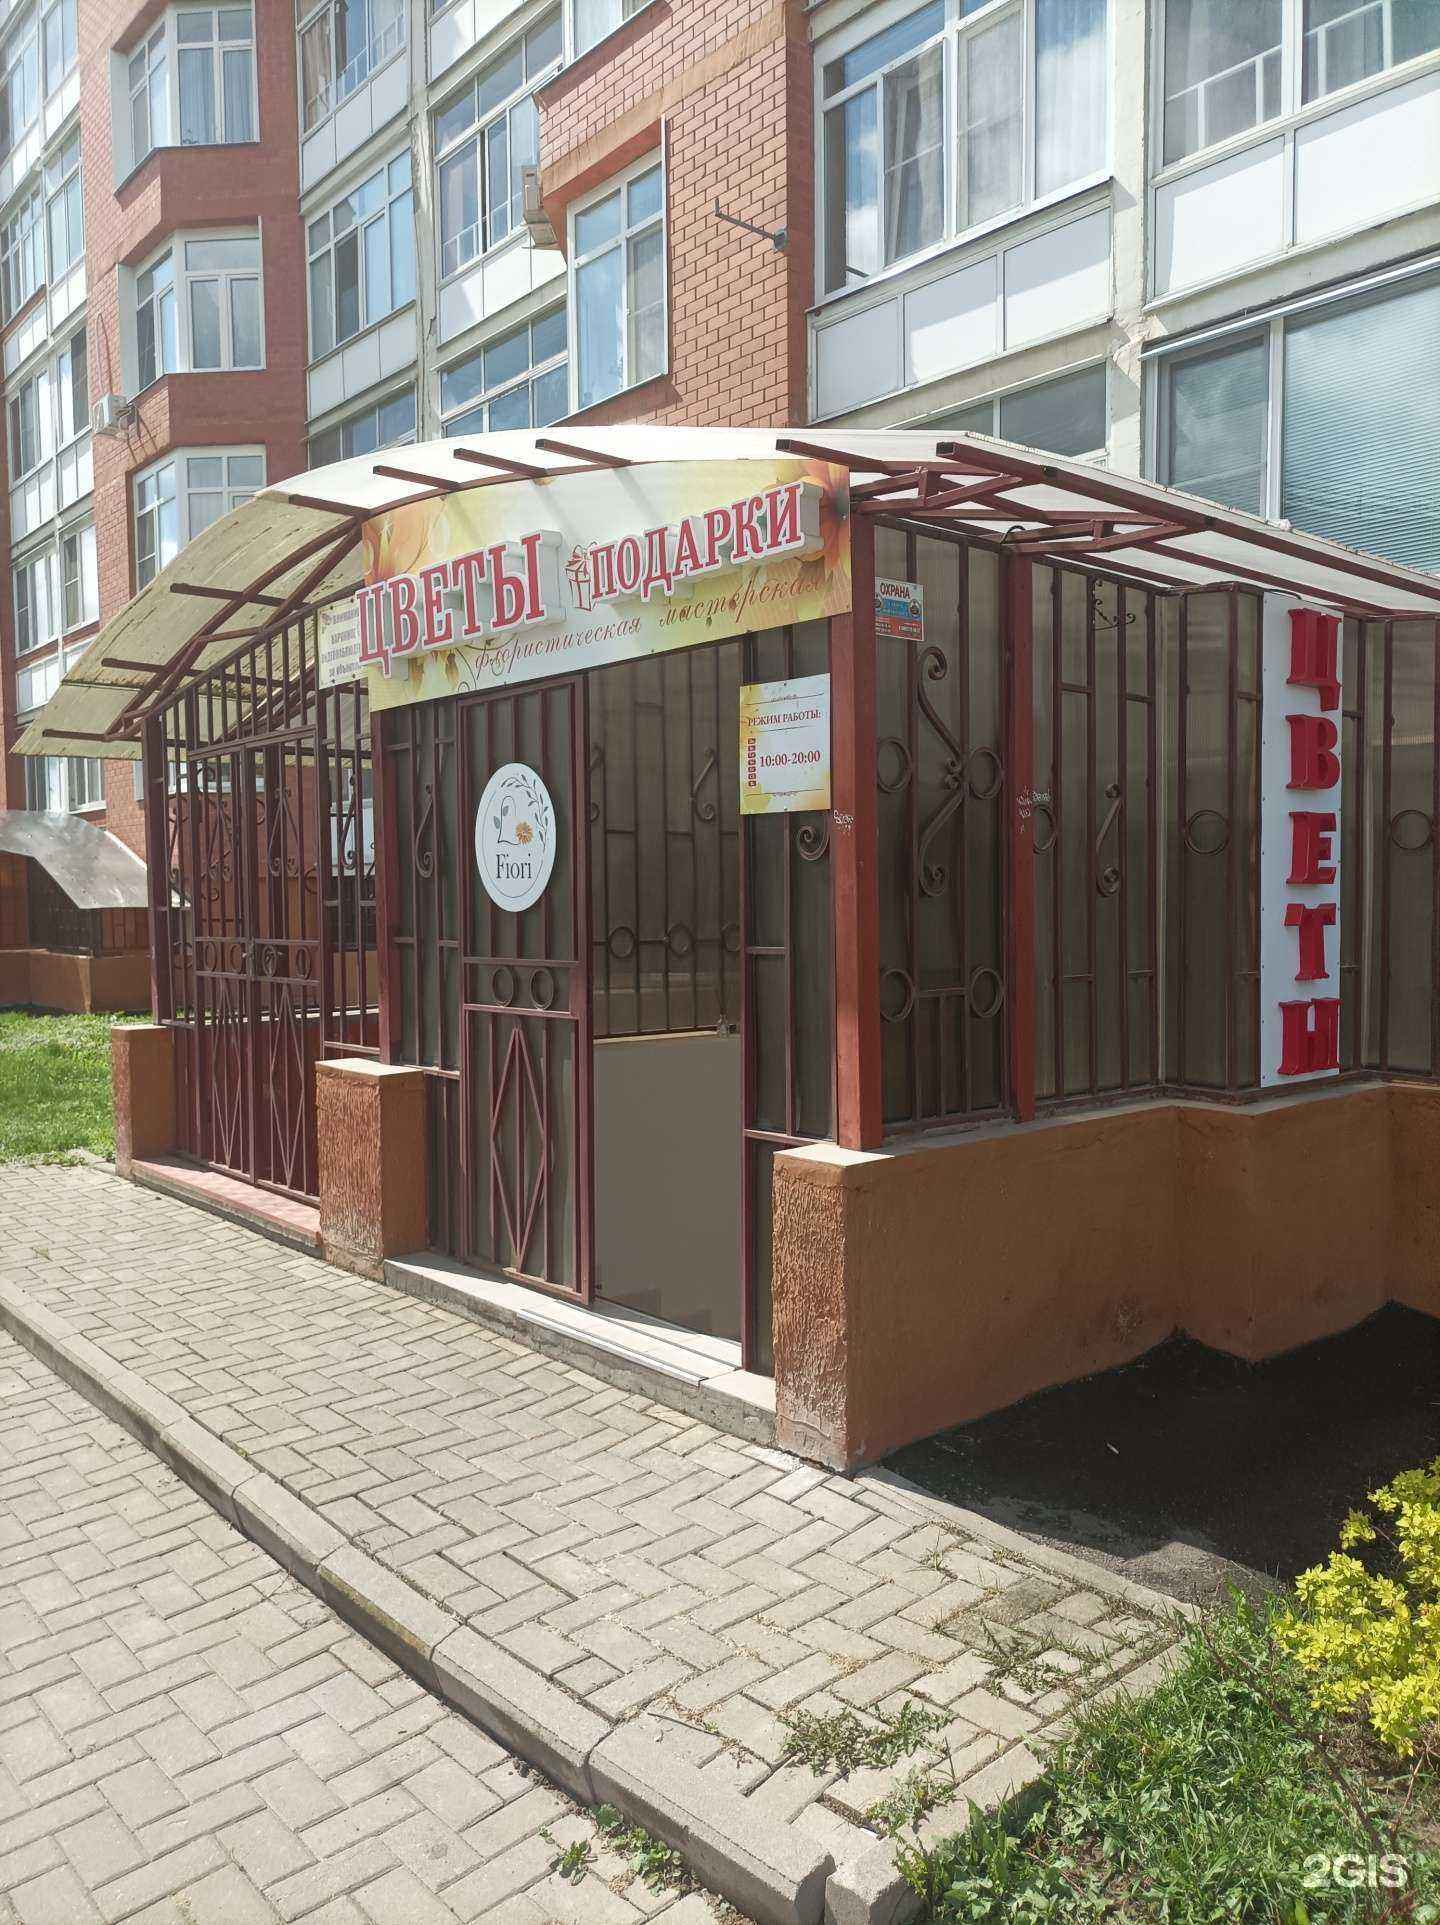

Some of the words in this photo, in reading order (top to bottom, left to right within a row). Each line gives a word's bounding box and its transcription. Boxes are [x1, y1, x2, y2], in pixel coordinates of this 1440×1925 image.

[356, 533, 546, 677] ЦВЕТЫ
[589, 483, 804, 602] ПОДАРКИ
[880, 582, 911, 600] ОХРАНА
[473, 615, 641, 681] флористическая
[748, 711, 782, 727] РЕЖИМ
[783, 708, 822, 723] РАБОТЫ:
[759, 750, 821, 768] 10:00-20:00
[495, 852, 532, 879] Fiori
